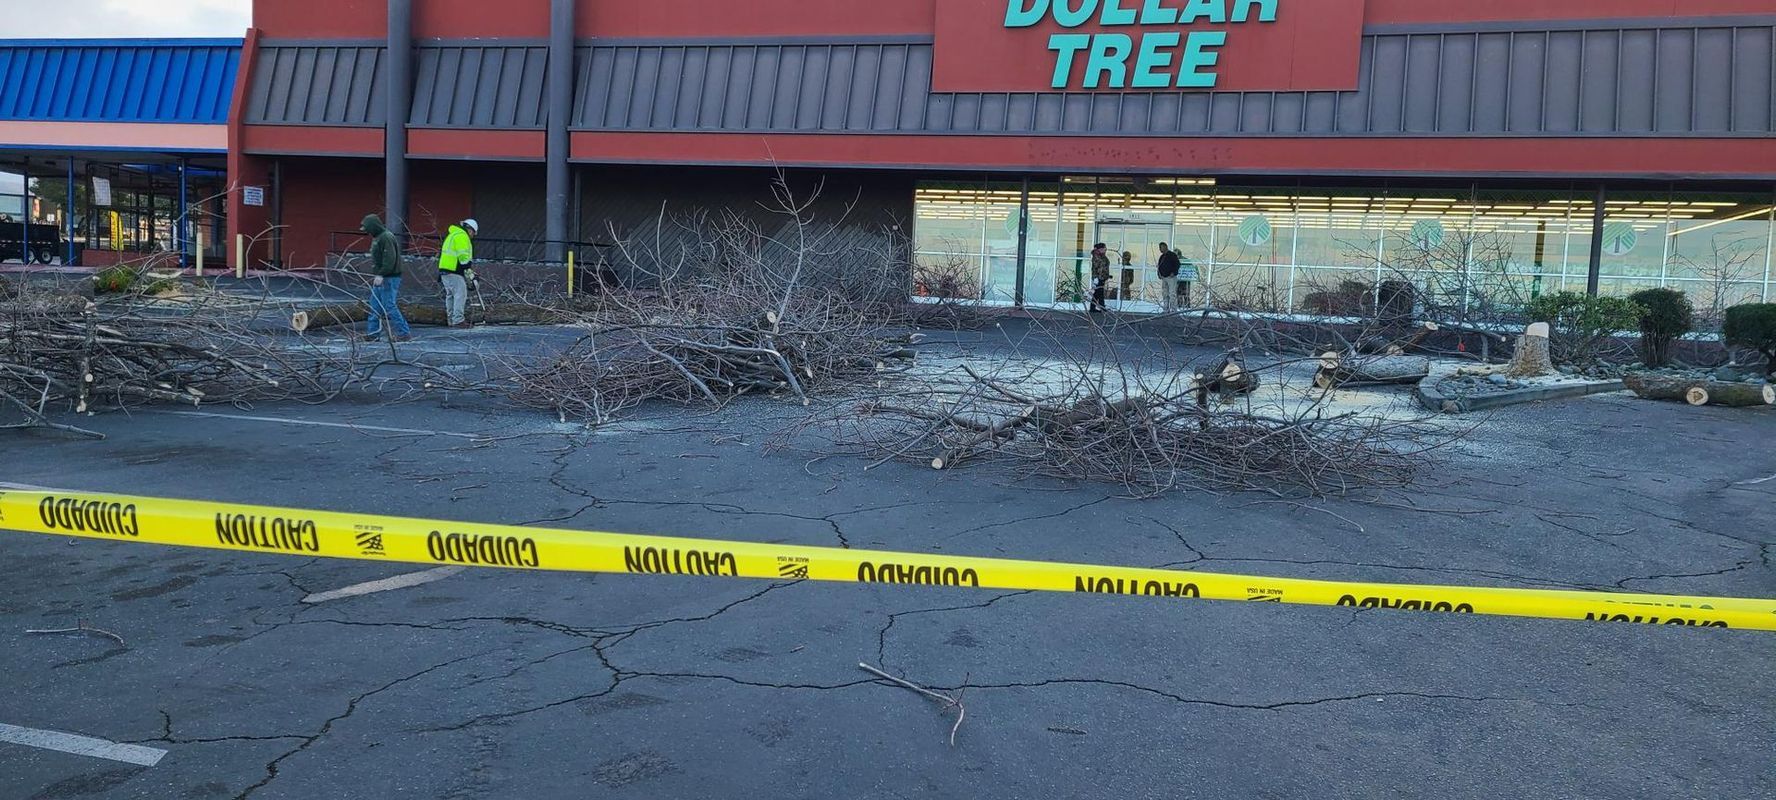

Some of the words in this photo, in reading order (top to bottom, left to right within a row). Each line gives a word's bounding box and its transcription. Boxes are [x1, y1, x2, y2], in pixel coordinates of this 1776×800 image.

[1048, 31, 1226, 88] TREE
[38, 495, 139, 537] CUIDADO
[214, 512, 320, 553] CAUTION
[426, 530, 540, 568] CUIDADO
[624, 545, 739, 578] CAUTION
[857, 561, 979, 588] CUIDADO
